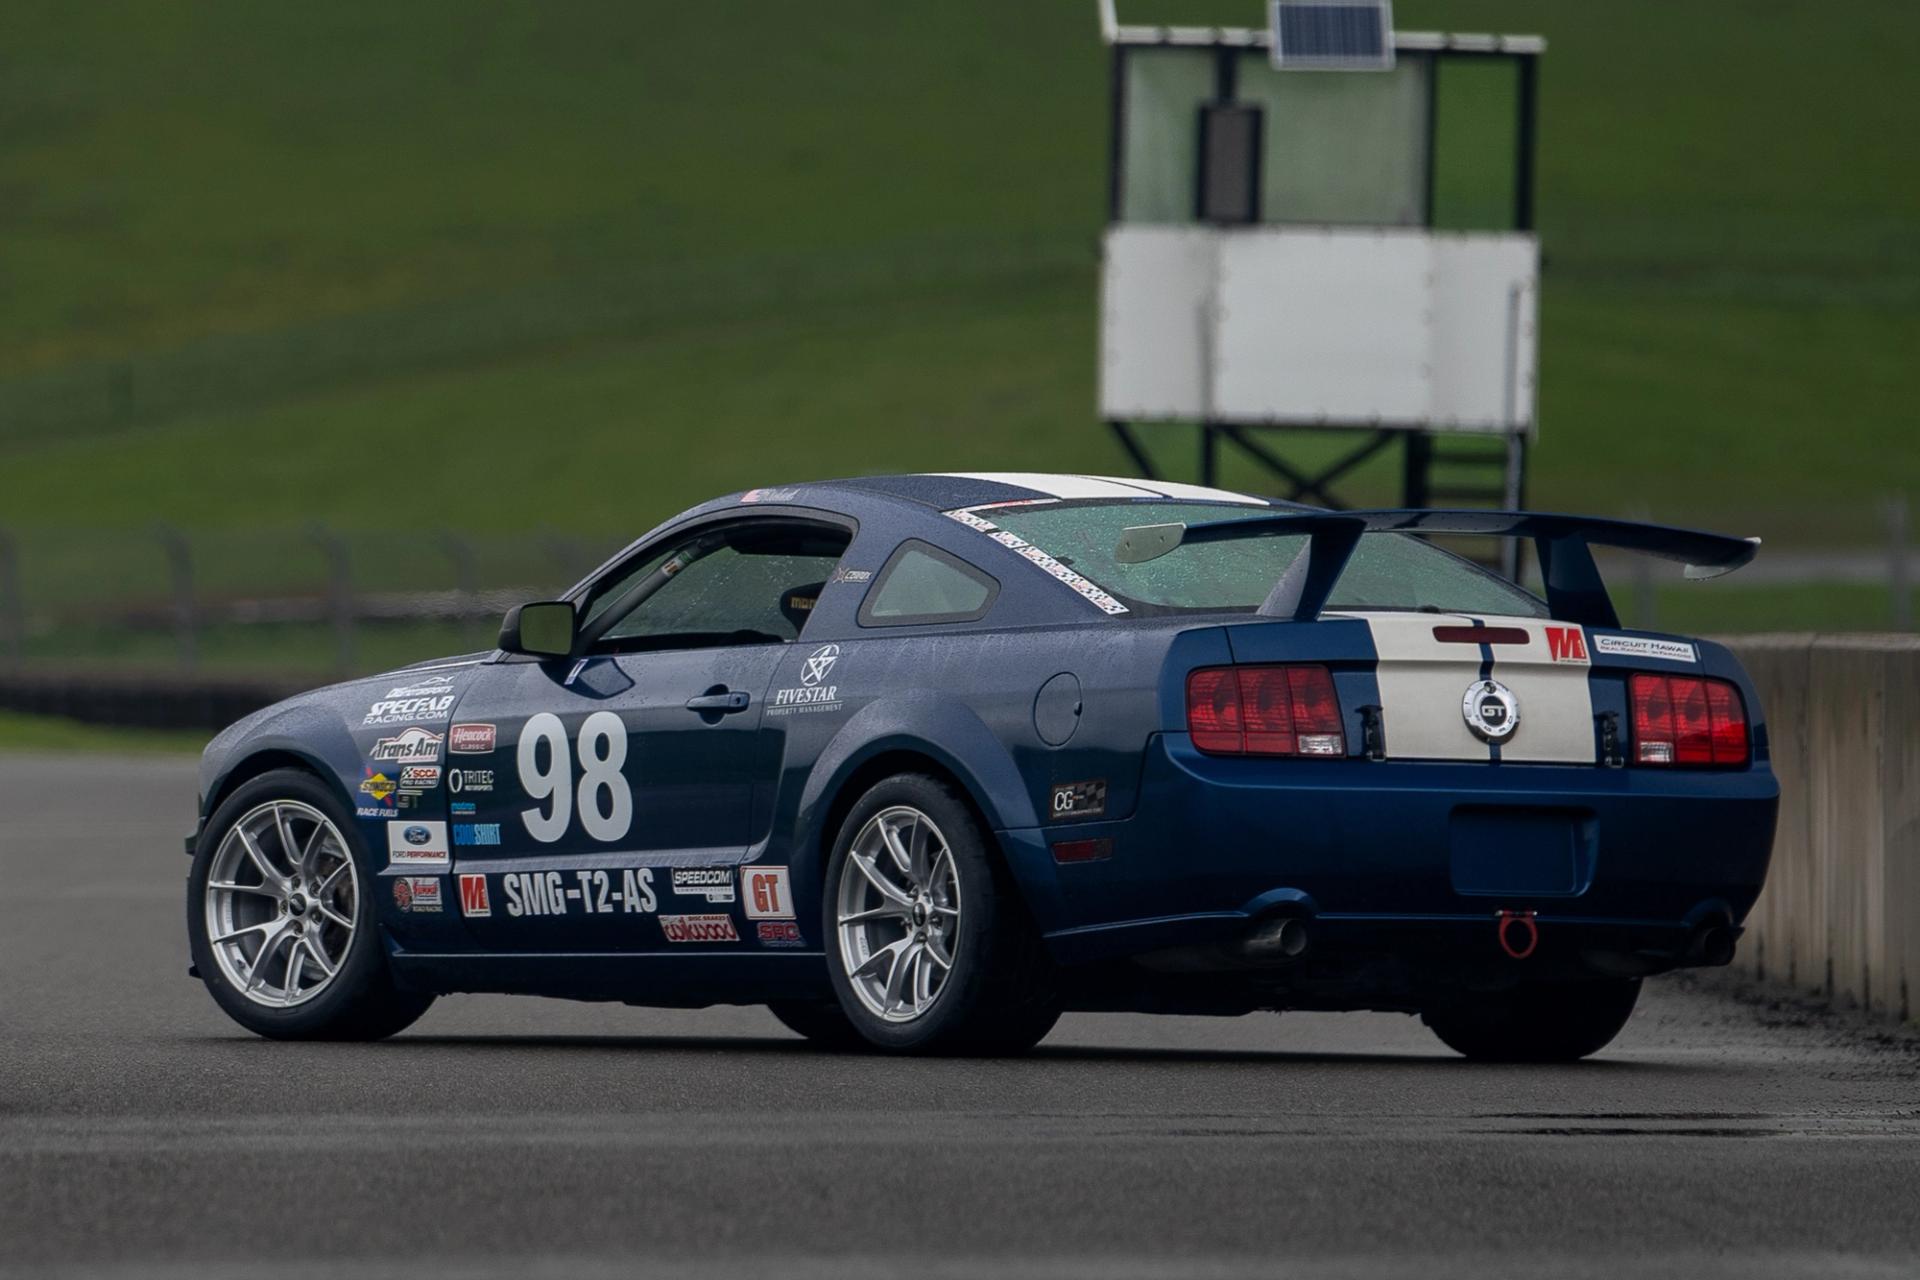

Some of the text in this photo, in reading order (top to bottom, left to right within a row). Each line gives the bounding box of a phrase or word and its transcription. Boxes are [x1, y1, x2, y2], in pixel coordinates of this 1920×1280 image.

[1600, 638, 1689, 653] CIRCUIT HAWAII
[775, 685, 837, 705] FIVESTAR
[366, 695, 456, 717] SPECFAB
[766, 704, 842, 716] PROPERTY MANAGEMENT
[1481, 705, 1505, 717] GT
[362, 711, 448, 725] RACING.COM
[377, 737, 438, 758] Trans Am
[412, 769, 438, 778] SCCA
[464, 770, 494, 784] TRITEC
[517, 711, 633, 843] 98
[1054, 791, 1073, 811] CG
[356, 807, 399, 817] RACE FUELS
[408, 829, 427, 842] Ford
[406, 851, 447, 859] PERFORMANCE
[674, 870, 731, 885] SPEEDCOM
[503, 867, 658, 917] SMG-T2-AS
[752, 873, 780, 913] GT
